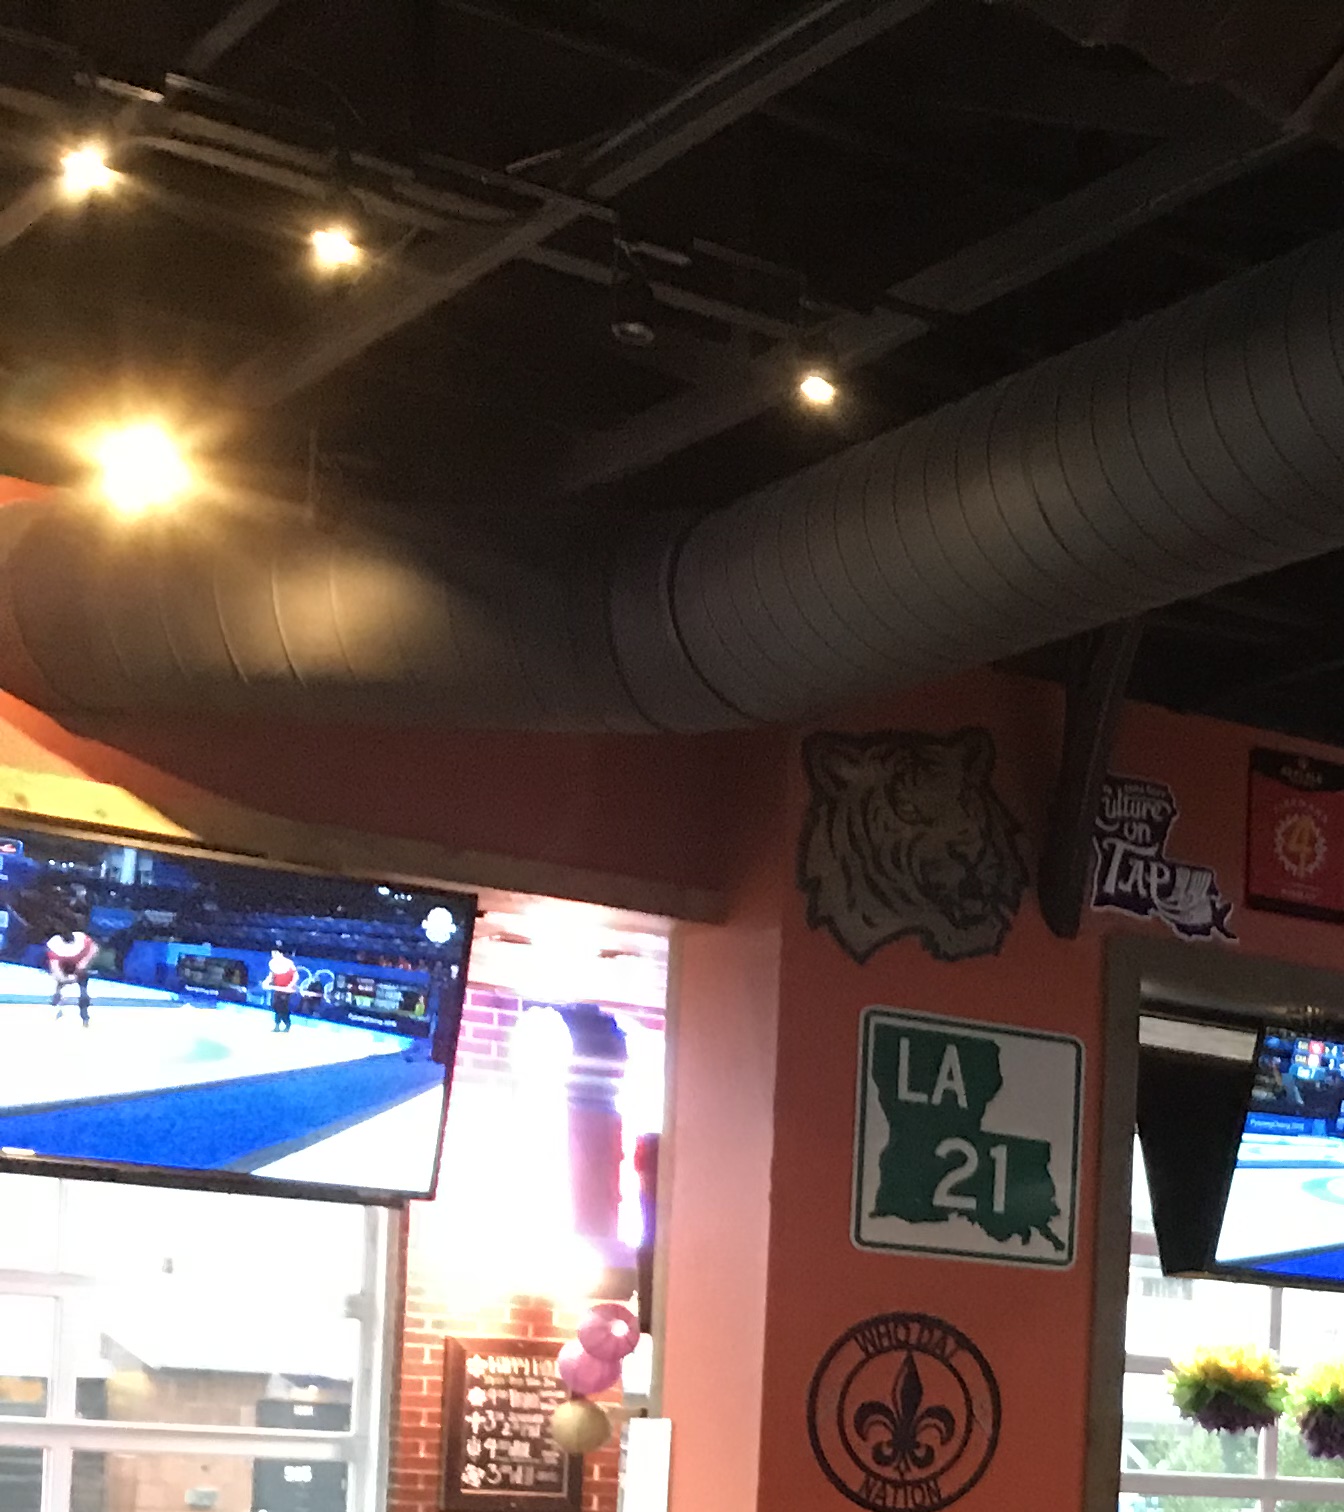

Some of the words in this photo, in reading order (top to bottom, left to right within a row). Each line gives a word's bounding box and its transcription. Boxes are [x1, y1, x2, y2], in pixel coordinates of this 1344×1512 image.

[1124, 821, 1151, 844] on
[897, 1037, 968, 1110] LA
[932, 1137, 1008, 1214] 21
[854, 1322, 910, 1356] WHO
[918, 1324, 959, 1360] DAT
[858, 1475, 942, 1508] NATION
